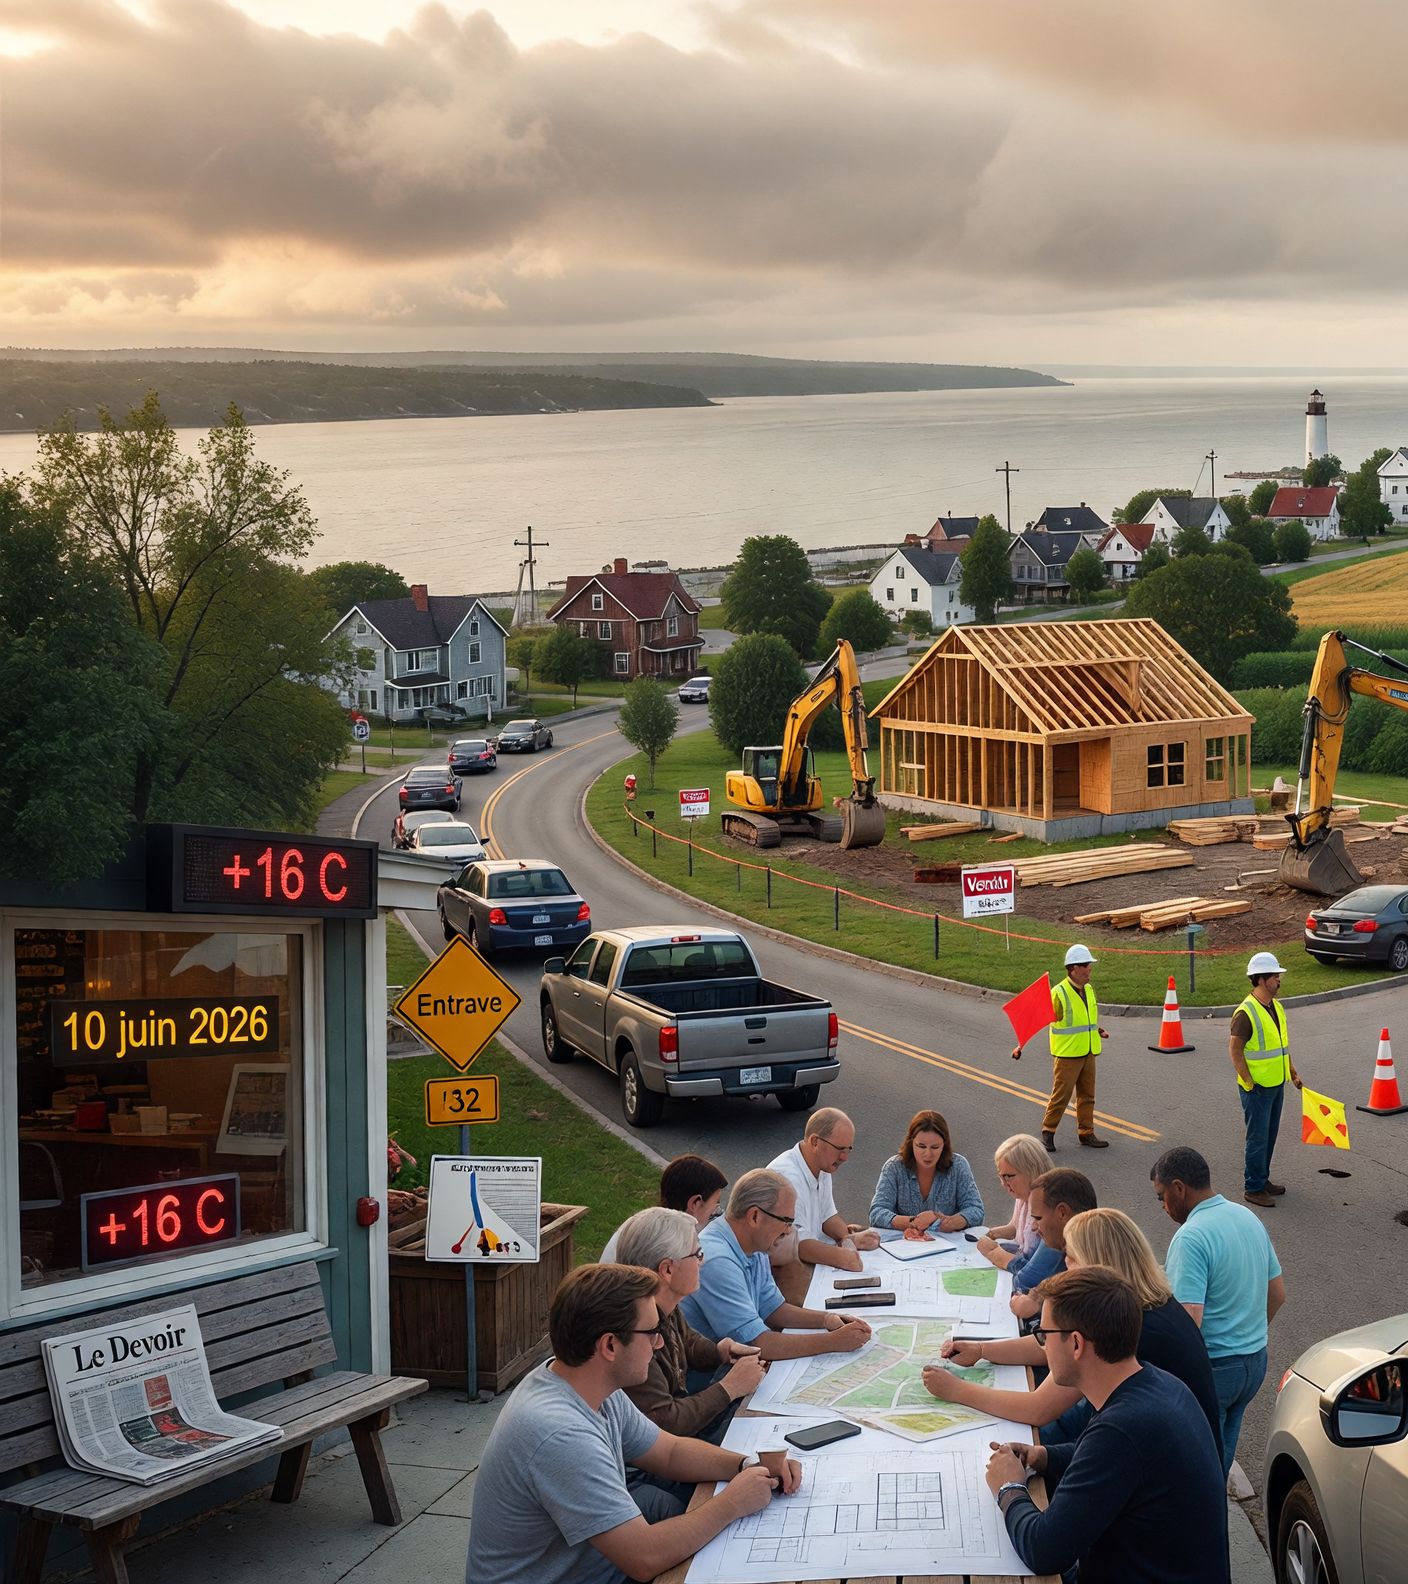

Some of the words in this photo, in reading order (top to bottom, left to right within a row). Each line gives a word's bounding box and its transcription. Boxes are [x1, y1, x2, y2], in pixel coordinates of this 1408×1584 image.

[223, 847, 305, 900] +16
[319, 852, 348, 901] C
[417, 993, 502, 1016] Entrave
[63, 1010, 106, 1050] 10
[116, 1009, 176, 1058] juin
[189, 1005, 268, 1044] 2026
[99, 1194, 181, 1246] +16
[196, 1188, 225, 1235] C
[71, 1344, 105, 1373] Le
[107, 1324, 186, 1363] Devoir
